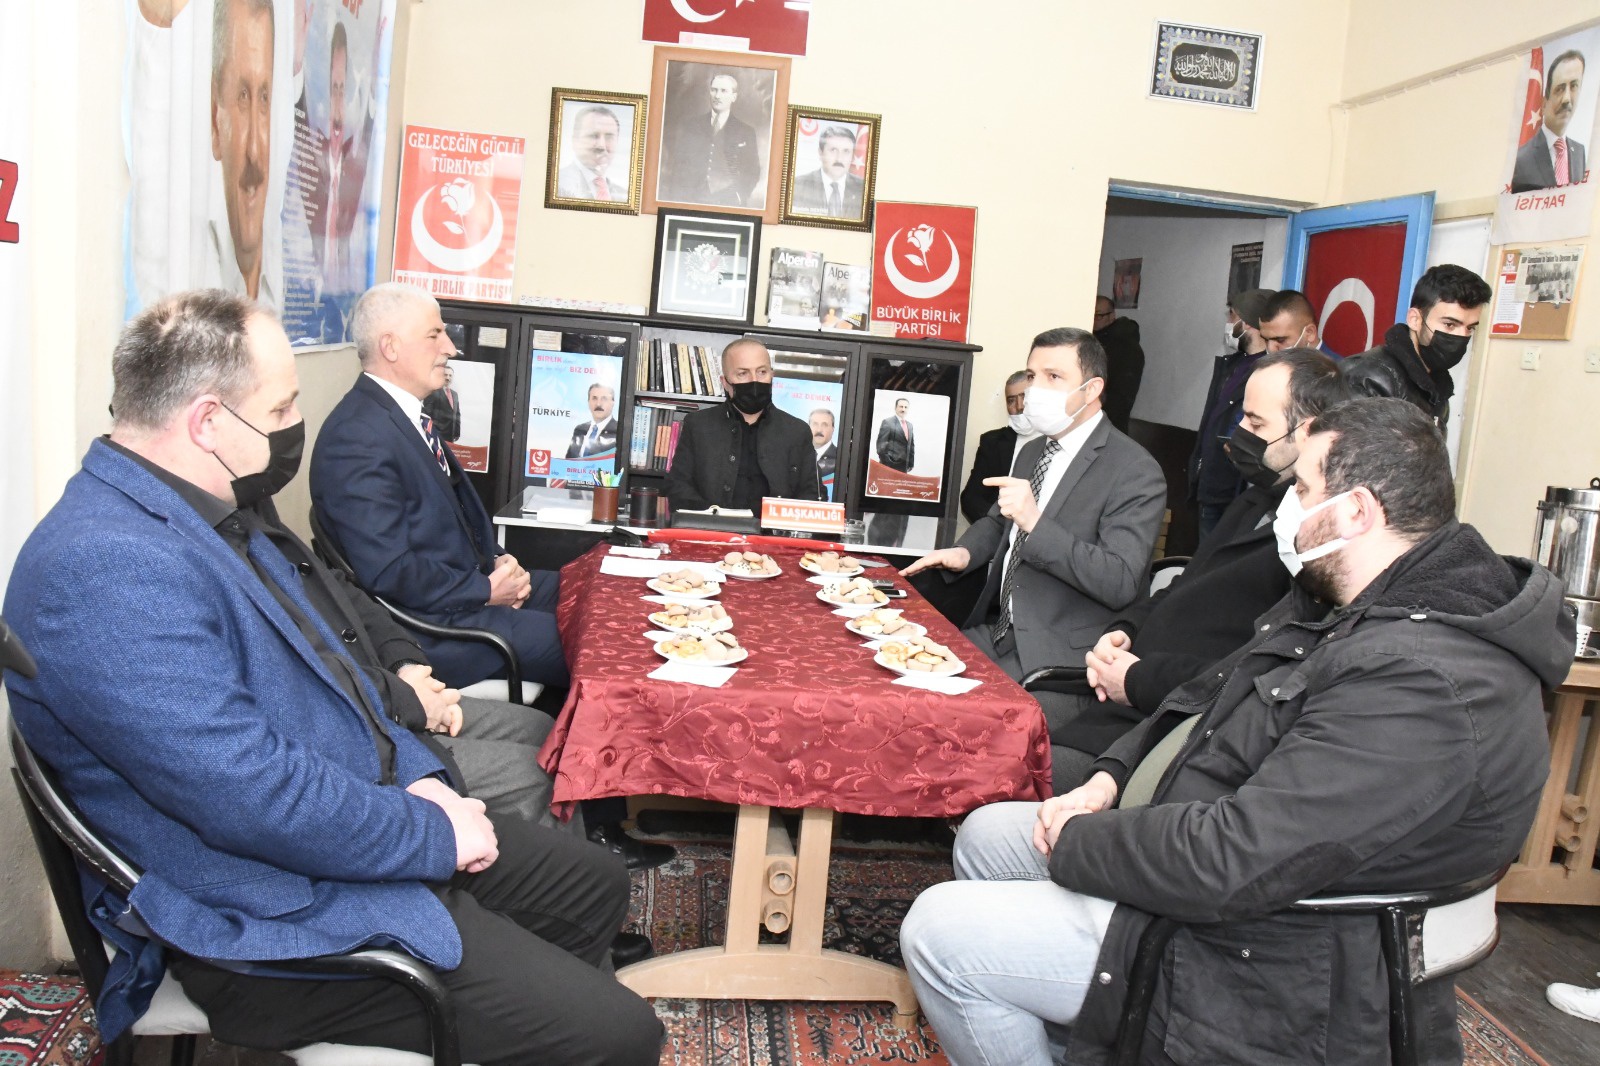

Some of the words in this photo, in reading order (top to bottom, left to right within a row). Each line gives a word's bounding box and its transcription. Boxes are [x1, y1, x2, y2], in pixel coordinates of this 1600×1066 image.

[409, 132, 477, 154] GELECEĞİN
[432, 154, 494, 177] TÜRKİYESİ
[778, 252, 818, 268] Alperen
[432, 276, 464, 295] BİRLİK
[877, 305, 919, 321] BÜYÜK
[922, 306, 960, 324] BİRLİK
[894, 322, 941, 336] PARTİSİ
[533, 406, 571, 417] TÜRKİYE
[769, 504, 778, 516] İL
[781, 507, 841, 521] BAŞKANLIĞI
